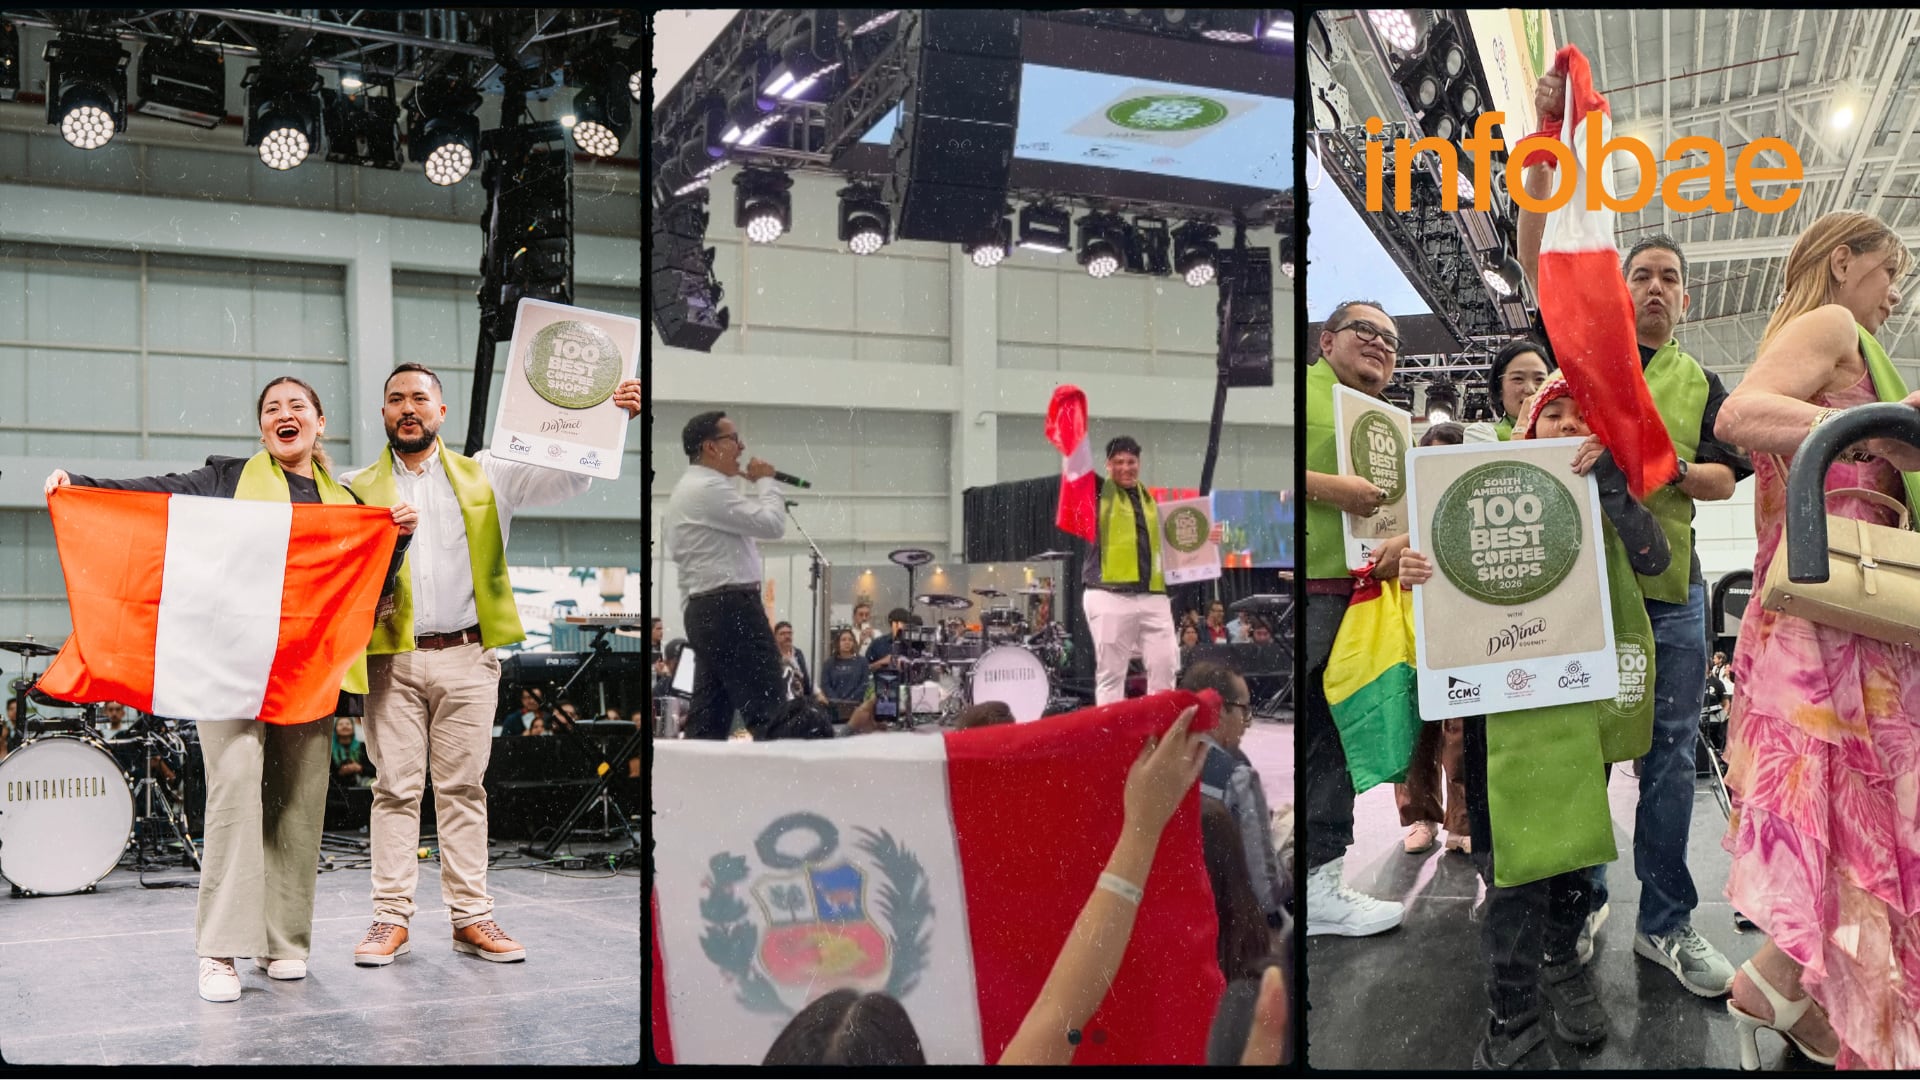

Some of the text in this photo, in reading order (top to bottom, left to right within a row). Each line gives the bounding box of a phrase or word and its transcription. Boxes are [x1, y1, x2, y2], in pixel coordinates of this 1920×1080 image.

[552, 339, 600, 362] 100
[548, 356, 599, 377] BEST
[546, 370, 595, 386] COFFEE
[547, 379, 589, 395] SHOPS
[1367, 431, 1397, 456] 100
[1369, 451, 1398, 470] BEST
[1370, 466, 1399, 480] COFFEE
[1373, 476, 1398, 489] SHOPS
[1473, 484, 1534, 497] AMERICA'S
[1484, 477, 1521, 487] SOUTH
[1467, 494, 1542, 527] 100
[1470, 524, 1544, 551] BEST
[1471, 547, 1545, 566] COFFEE
[1477, 562, 1542, 581] SHOPS
[1500, 580, 1522, 589] 2026
[1486, 617, 1547, 656] DaVinci
[1619, 671, 1646, 685] EST
[1615, 693, 1643, 703] SHOPS
[1618, 685, 1646, 694] OFFEE
[8, 776, 106, 801] CONTRAVEREDA
